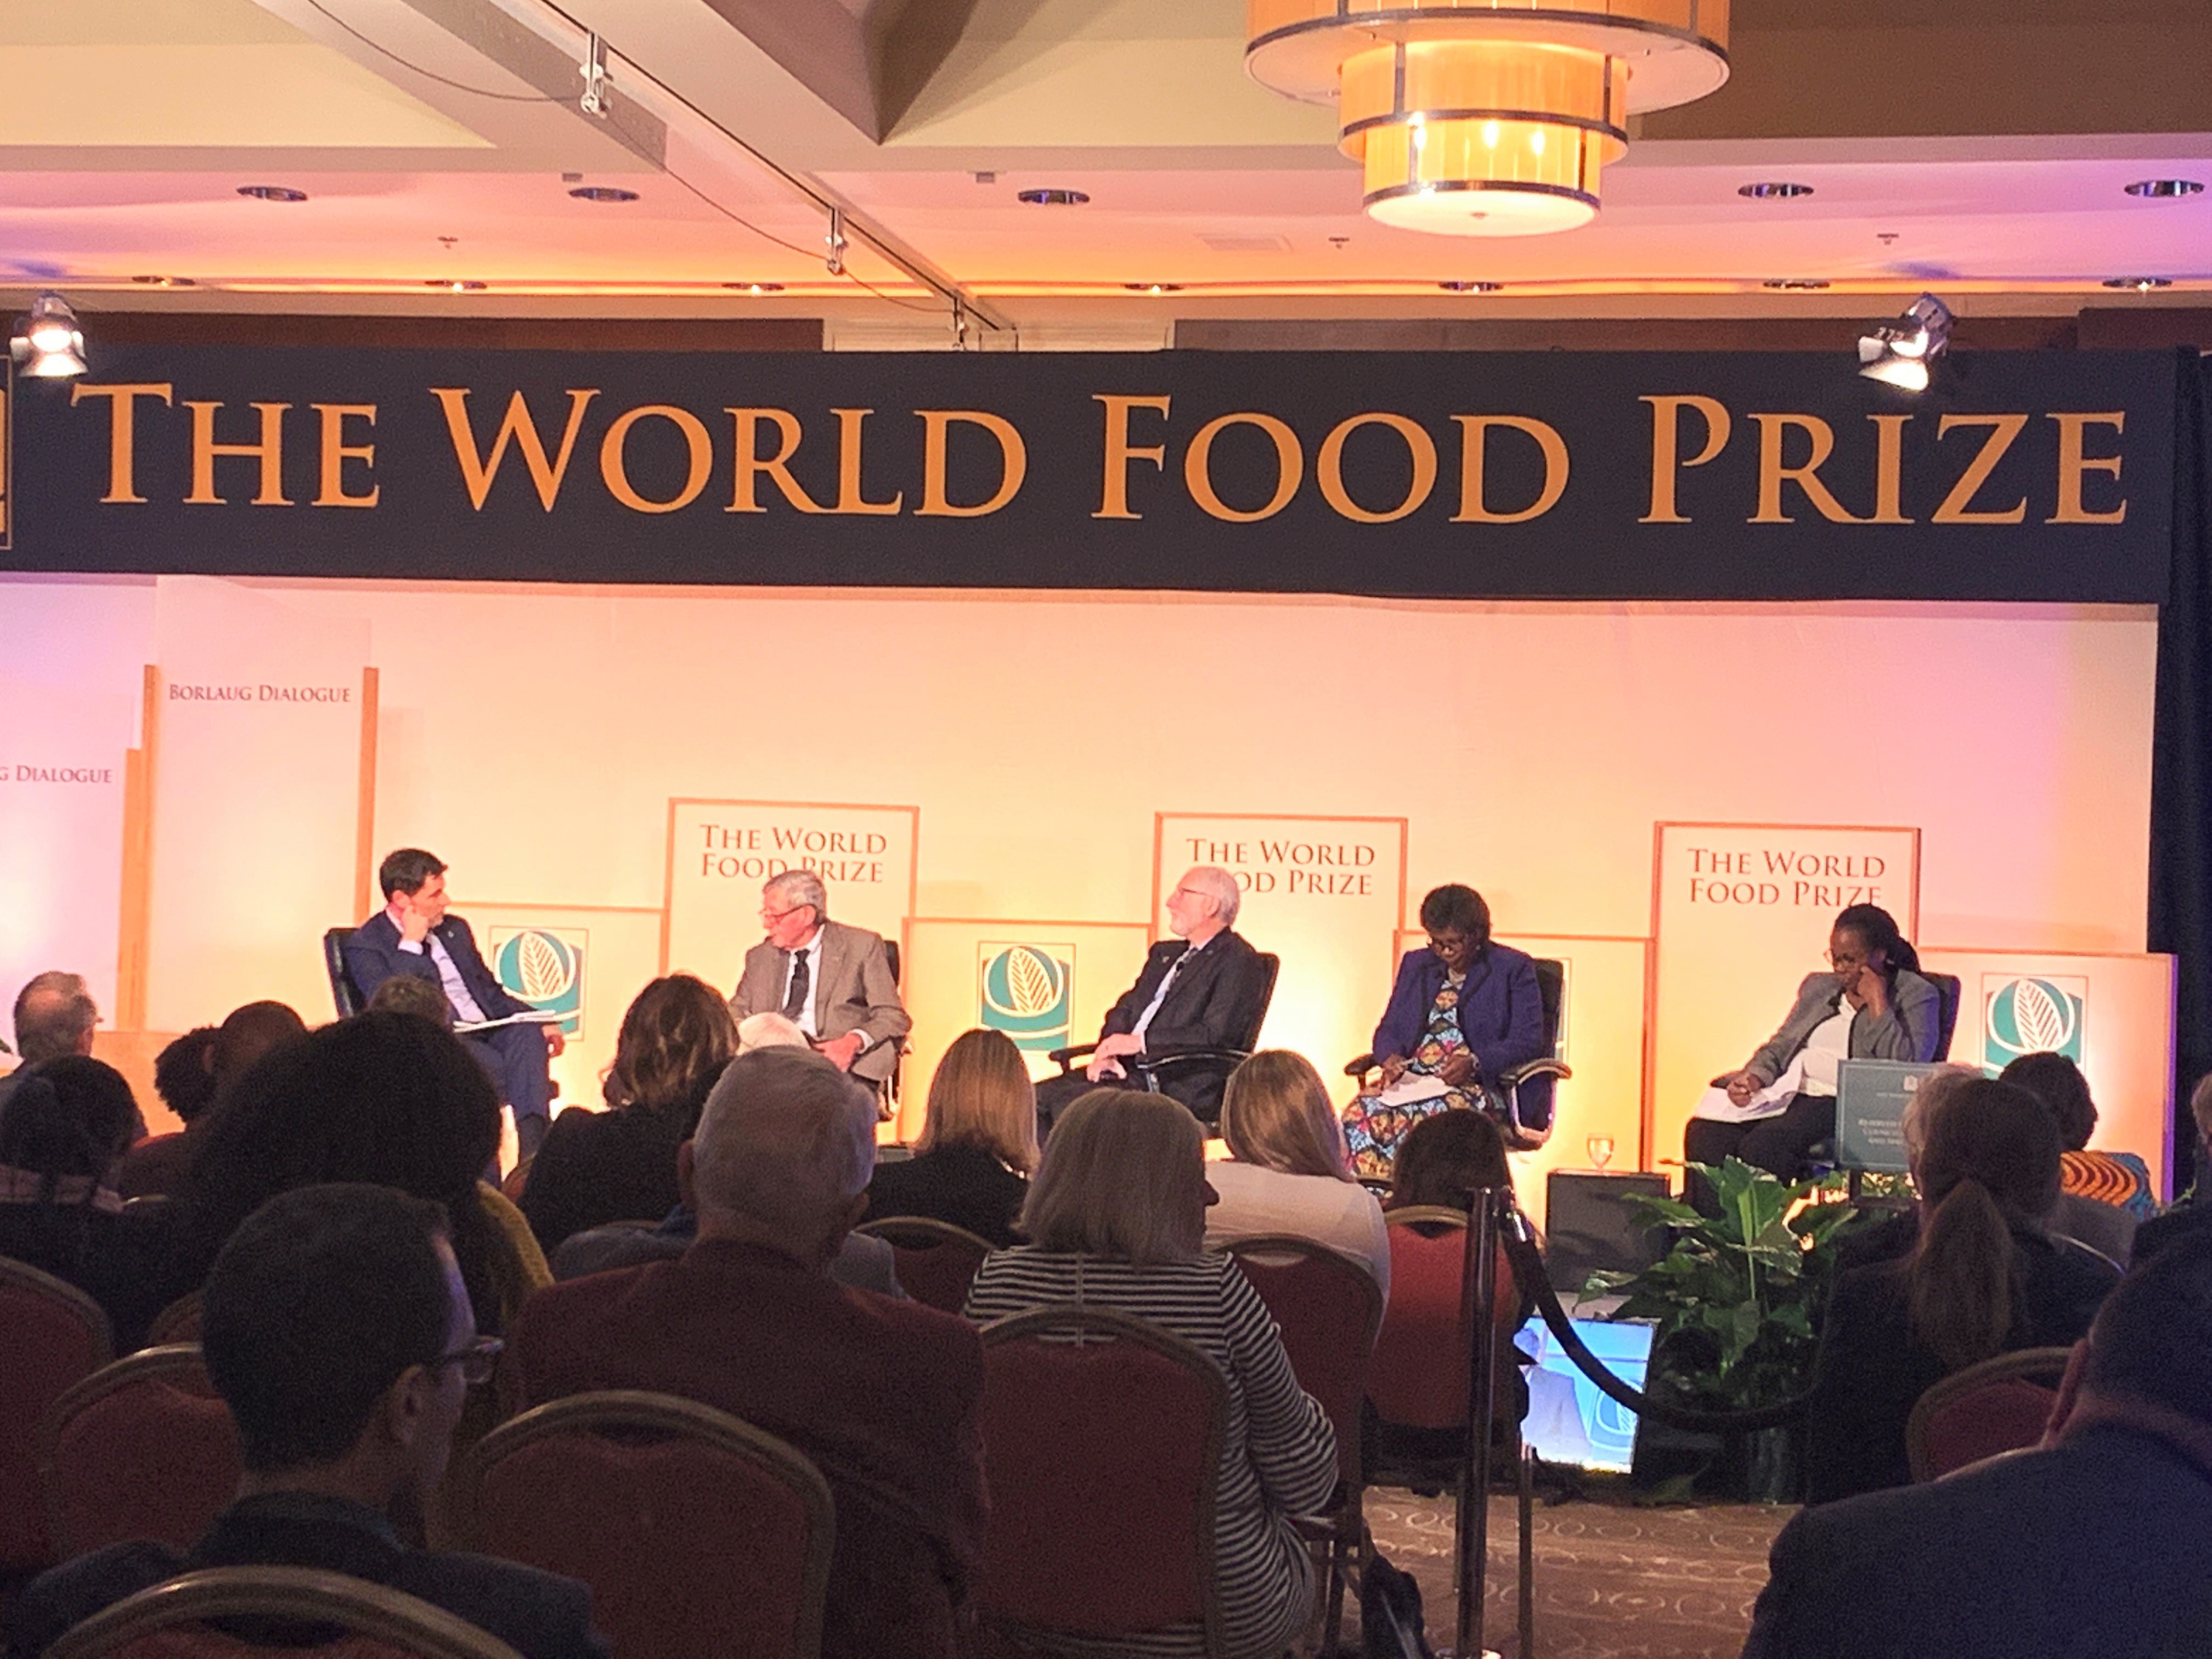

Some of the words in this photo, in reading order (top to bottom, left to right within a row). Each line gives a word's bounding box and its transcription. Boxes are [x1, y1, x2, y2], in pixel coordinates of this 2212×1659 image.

[72, 383, 380, 507] THE
[430, 387, 1025, 517] WORLD
[1093, 394, 1569, 523] FOOD
[1640, 391, 2127, 527] PRIZE
[169, 684, 252, 701] BORLAUG
[259, 685, 351, 702] DIALOGUE
[16, 765, 114, 783] DIALOGUE
[699, 825, 761, 850] THE
[772, 827, 887, 854] WORLD
[1186, 838, 1248, 863] THE
[1260, 840, 1375, 866] WORLD
[702, 853, 788, 878] FOOD
[1687, 849, 1752, 874] THE
[1763, 850, 1886, 878] WORLD
[1233, 871, 1276, 893] OD
[1289, 869, 1373, 895] PRIZE
[1690, 878, 1780, 905] FOOD
